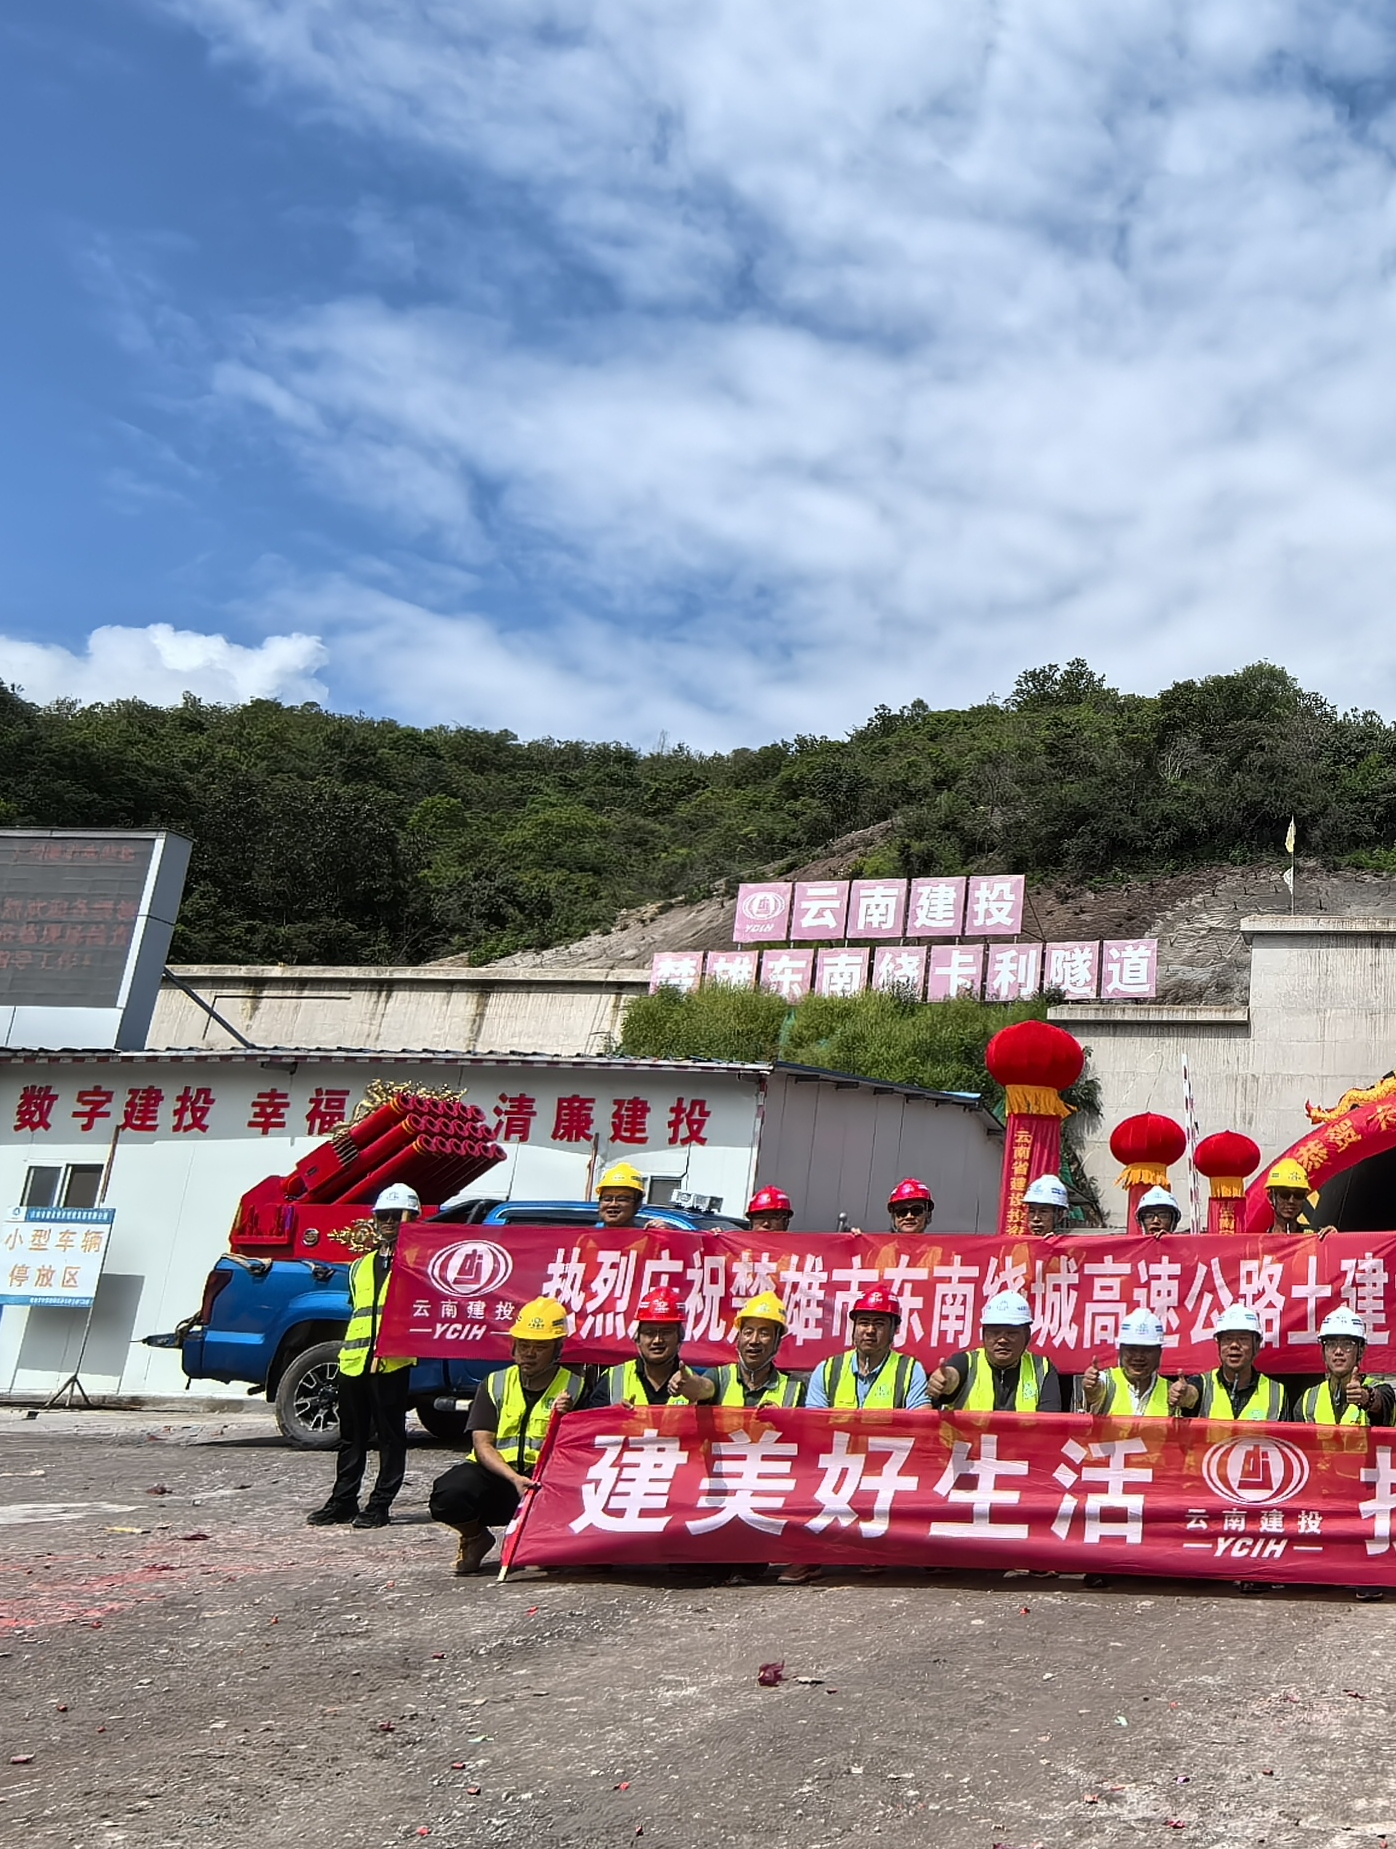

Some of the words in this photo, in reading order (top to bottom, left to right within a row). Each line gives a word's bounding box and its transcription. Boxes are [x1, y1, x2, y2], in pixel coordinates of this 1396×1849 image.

[800, 881, 1017, 930] 云南建投
[14, 1085, 216, 1133] 数字建投
[247, 1087, 351, 1136] 幸福
[493, 1092, 711, 1146] 清廉建投
[5, 1228, 104, 1253] 小型车辆
[9, 1264, 81, 1288] 停放区
[412, 1300, 515, 1320] 云南建投
[432, 1323, 487, 1341] YCIH
[569, 1428, 1154, 1547] 建美好生活
[1184, 1508, 1323, 1535] 云南建投
[1213, 1537, 1289, 1559] YCIH
